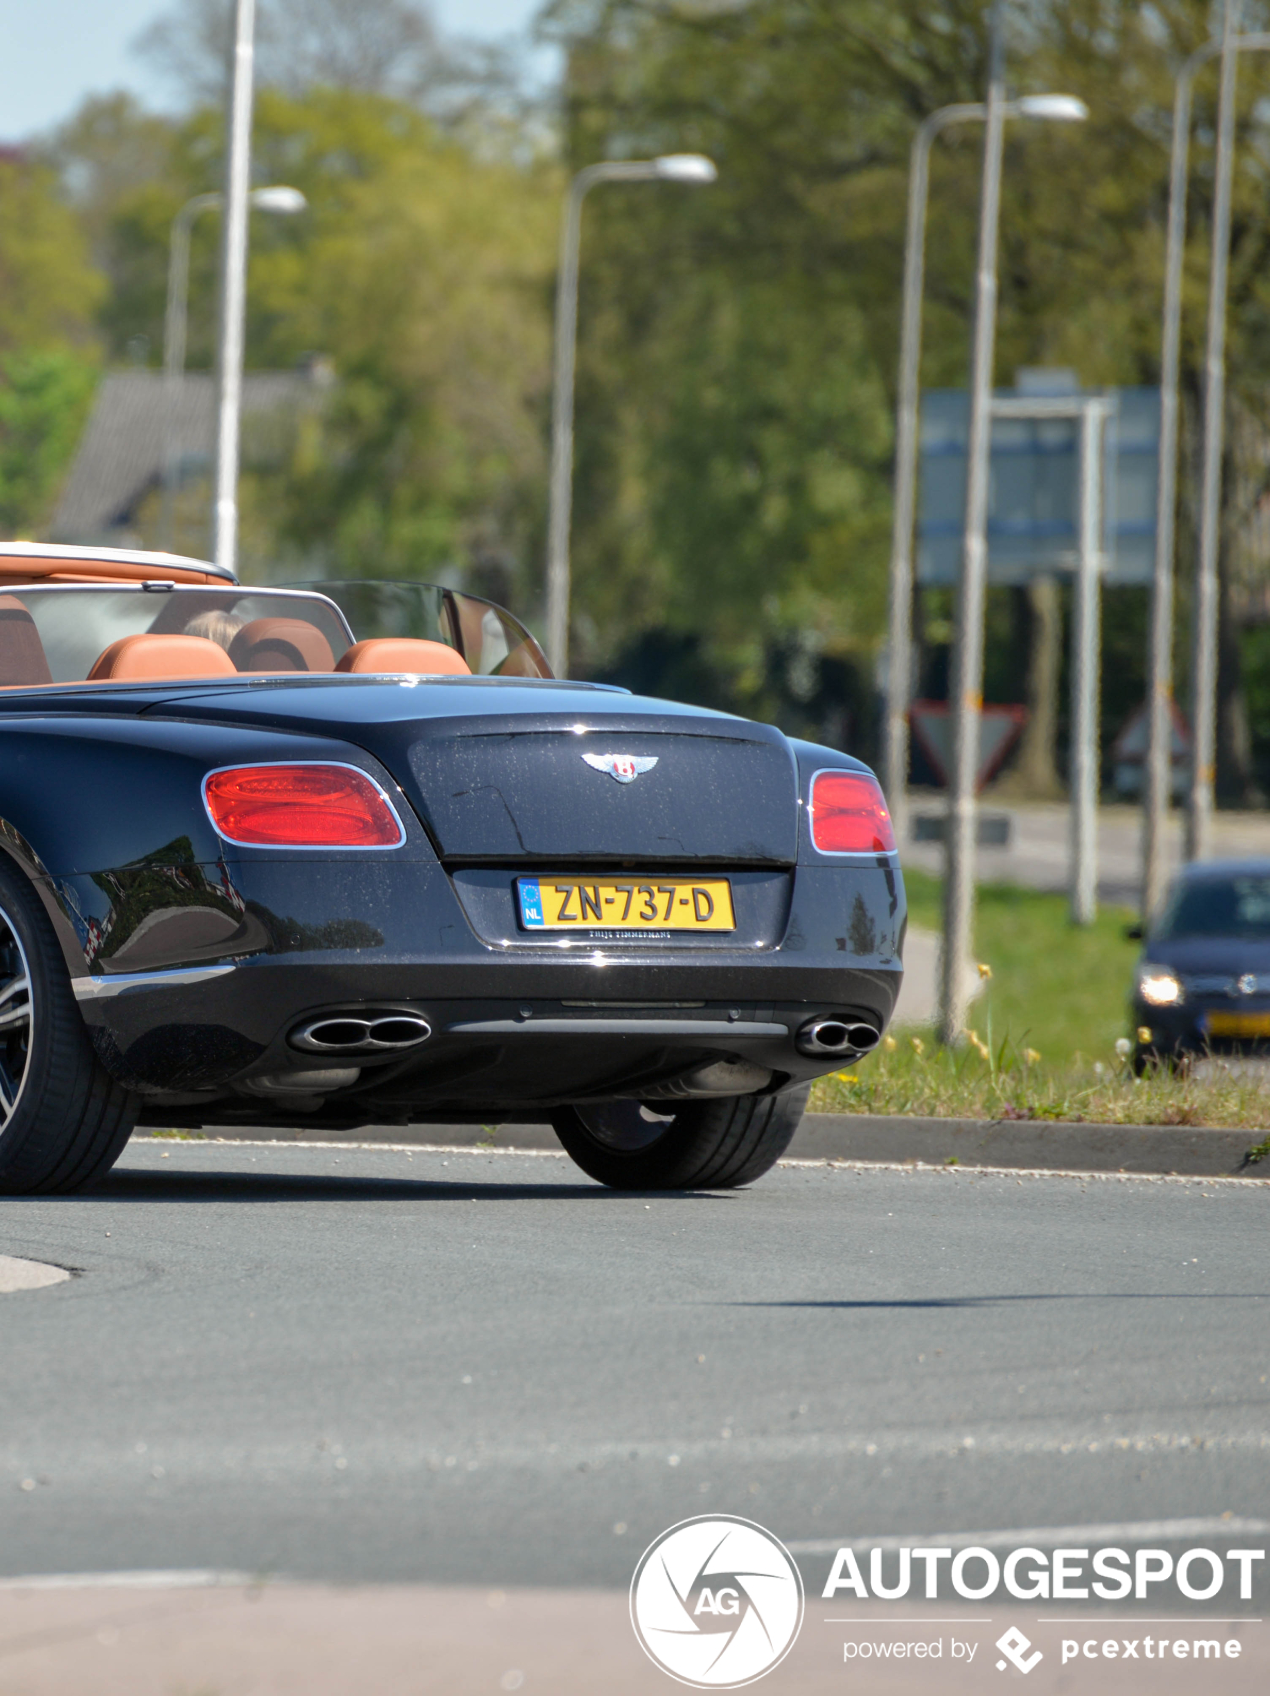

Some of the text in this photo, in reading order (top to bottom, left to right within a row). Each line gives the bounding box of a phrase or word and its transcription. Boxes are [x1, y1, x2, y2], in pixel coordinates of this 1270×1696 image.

[555, 885, 714, 922] ZN-737-D
[525, 908, 541, 919] NL
[589, 930, 613, 939] THIJS
